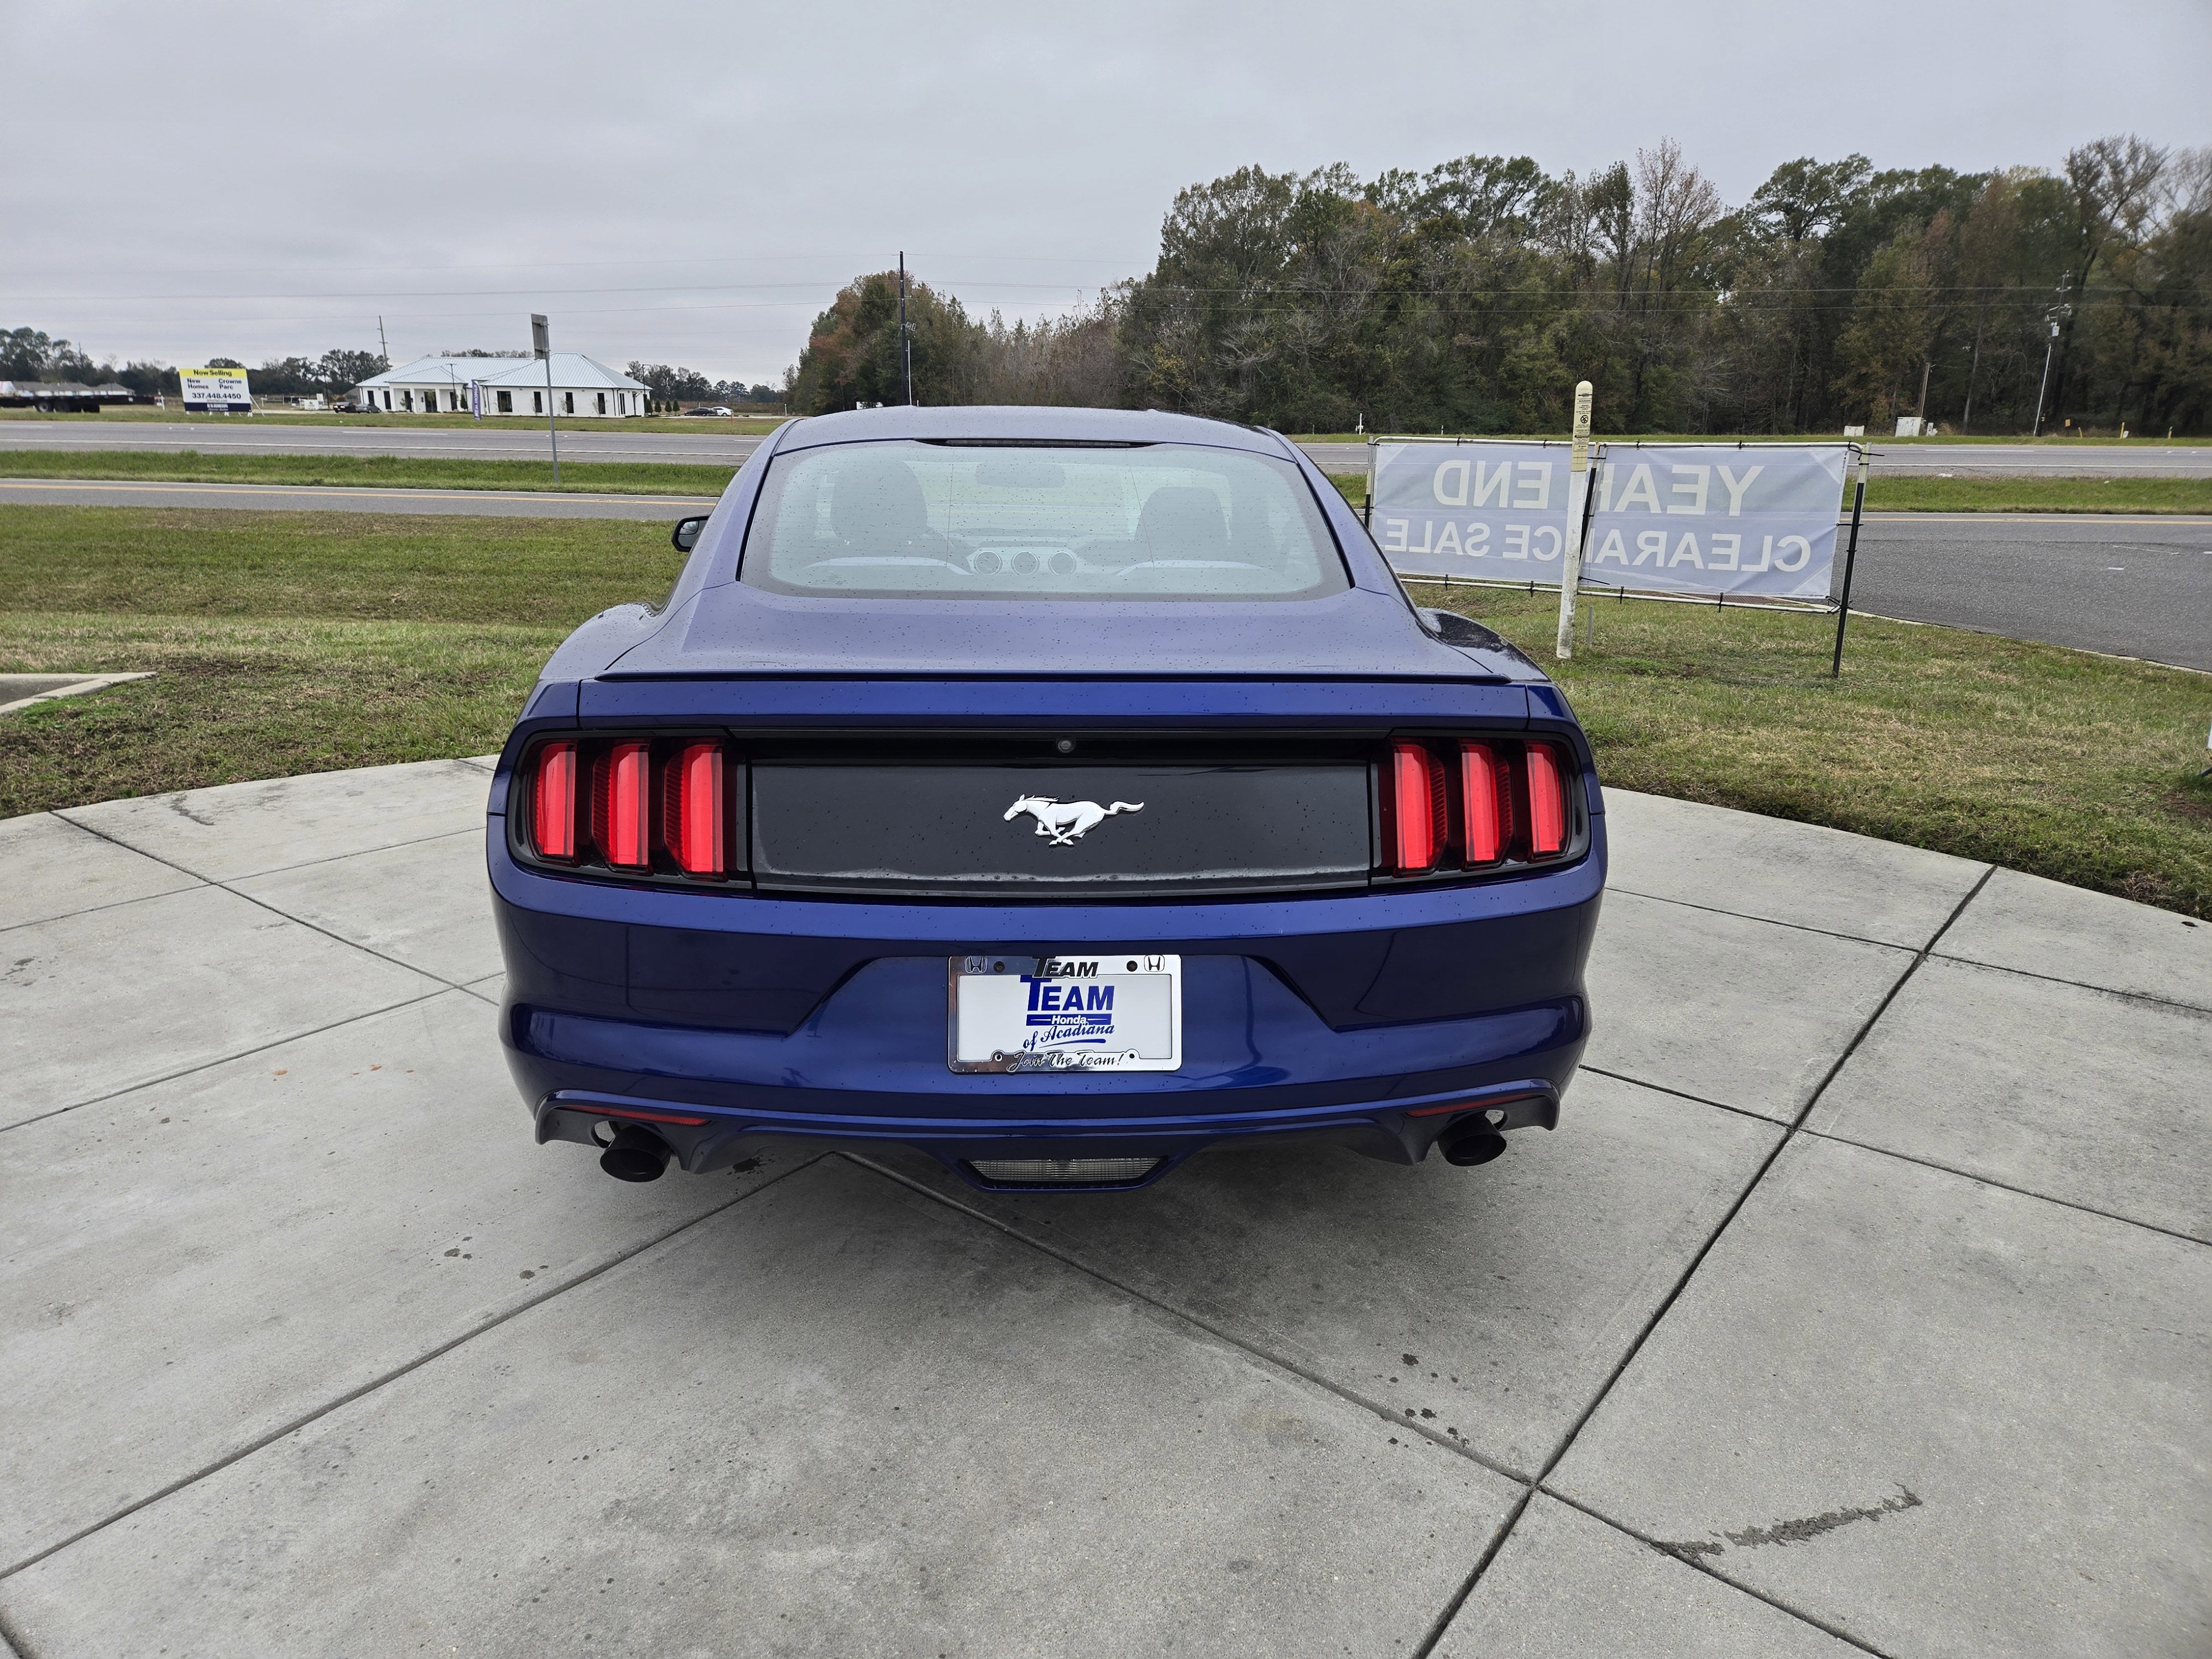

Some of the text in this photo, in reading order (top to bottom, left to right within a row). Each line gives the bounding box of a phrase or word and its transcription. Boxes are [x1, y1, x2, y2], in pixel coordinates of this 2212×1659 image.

[1032, 956, 1099, 977] TEAM
[1020, 974, 1115, 1011] TEAM
[1051, 1015, 1087, 1025] Honda
[1022, 1022, 1115, 1051] of Acadiana
[1006, 1051, 1124, 1072] Join The Team!
